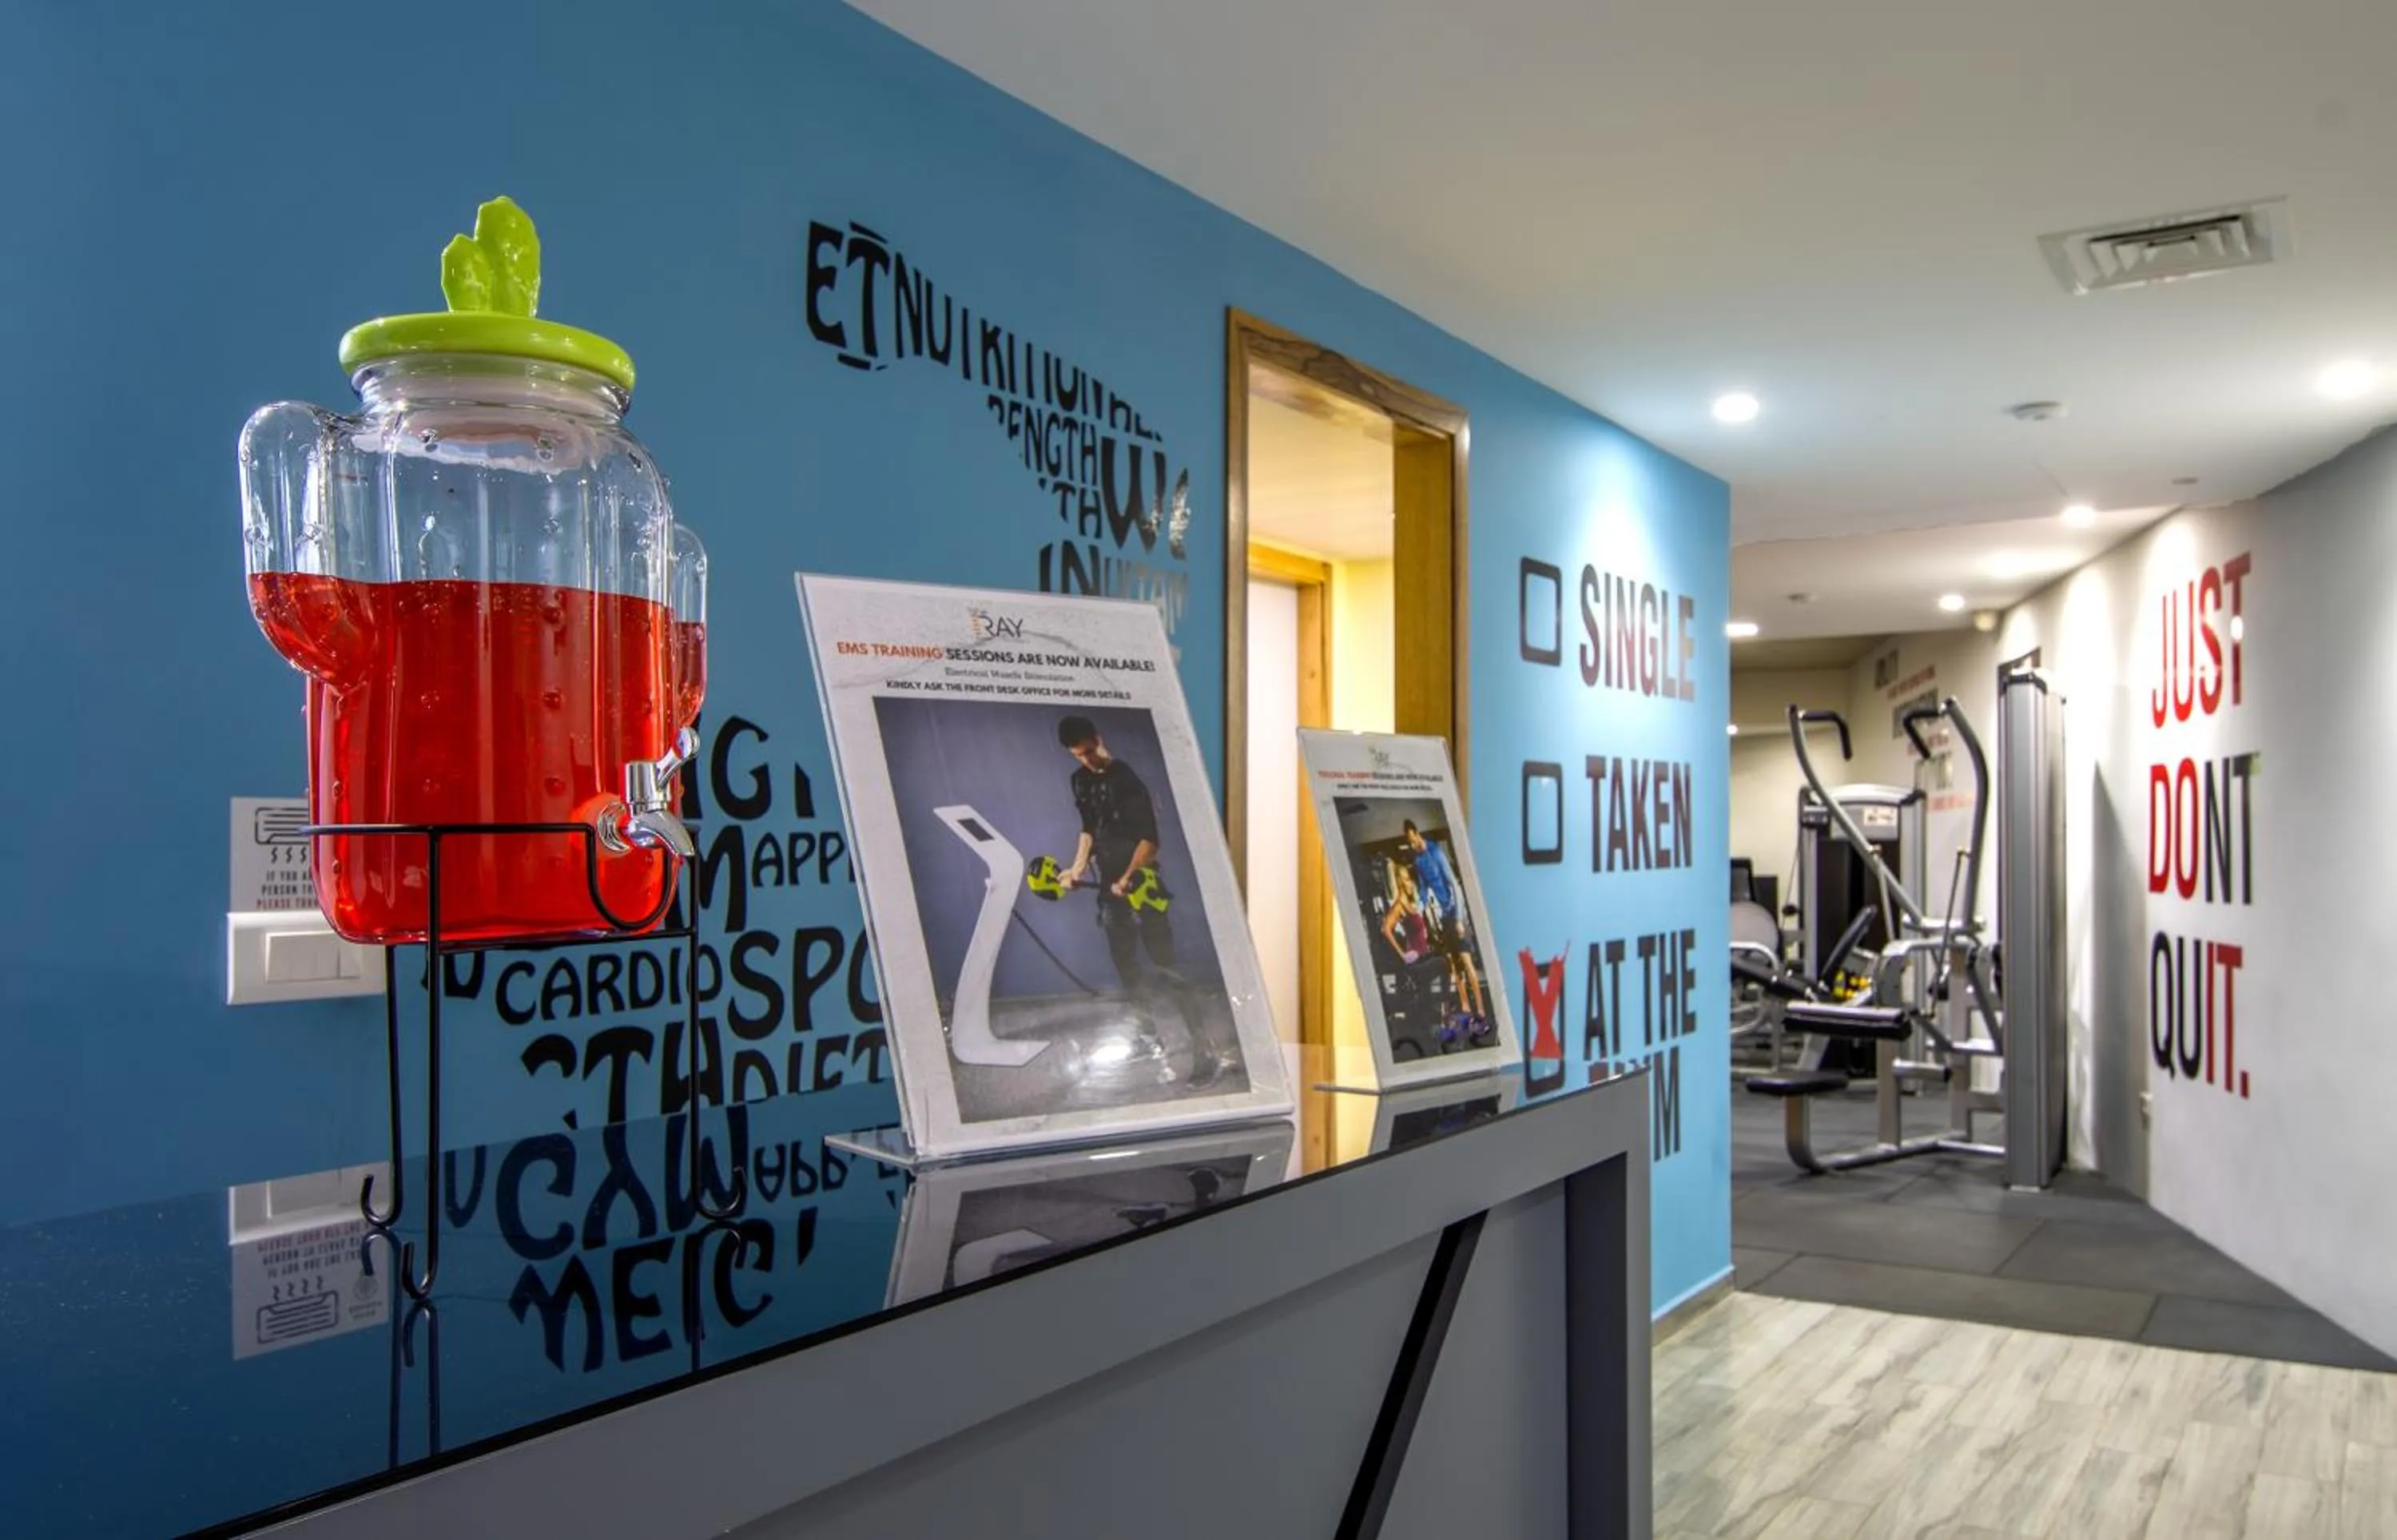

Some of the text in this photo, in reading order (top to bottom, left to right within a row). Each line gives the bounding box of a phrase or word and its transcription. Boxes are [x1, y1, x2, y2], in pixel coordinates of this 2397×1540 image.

[837, 641, 869, 655] EMS
[870, 644, 943, 659] TRAINING
[945, 648, 1015, 664] SESSIONS
[1017, 653, 1043, 665] ARE
[1046, 654, 1079, 668] NOW
[1579, 563, 1695, 703] SINGLE
[2153, 551, 2252, 728] JUST
[752, 832, 856, 887] APP
[1585, 755, 1693, 874] TAKEN
[2148, 752, 2260, 906] DONT
[495, 945, 723, 1025] CARDIO
[1583, 928, 1696, 1061] AT THE
[2149, 931, 2249, 1100] QUIT.
